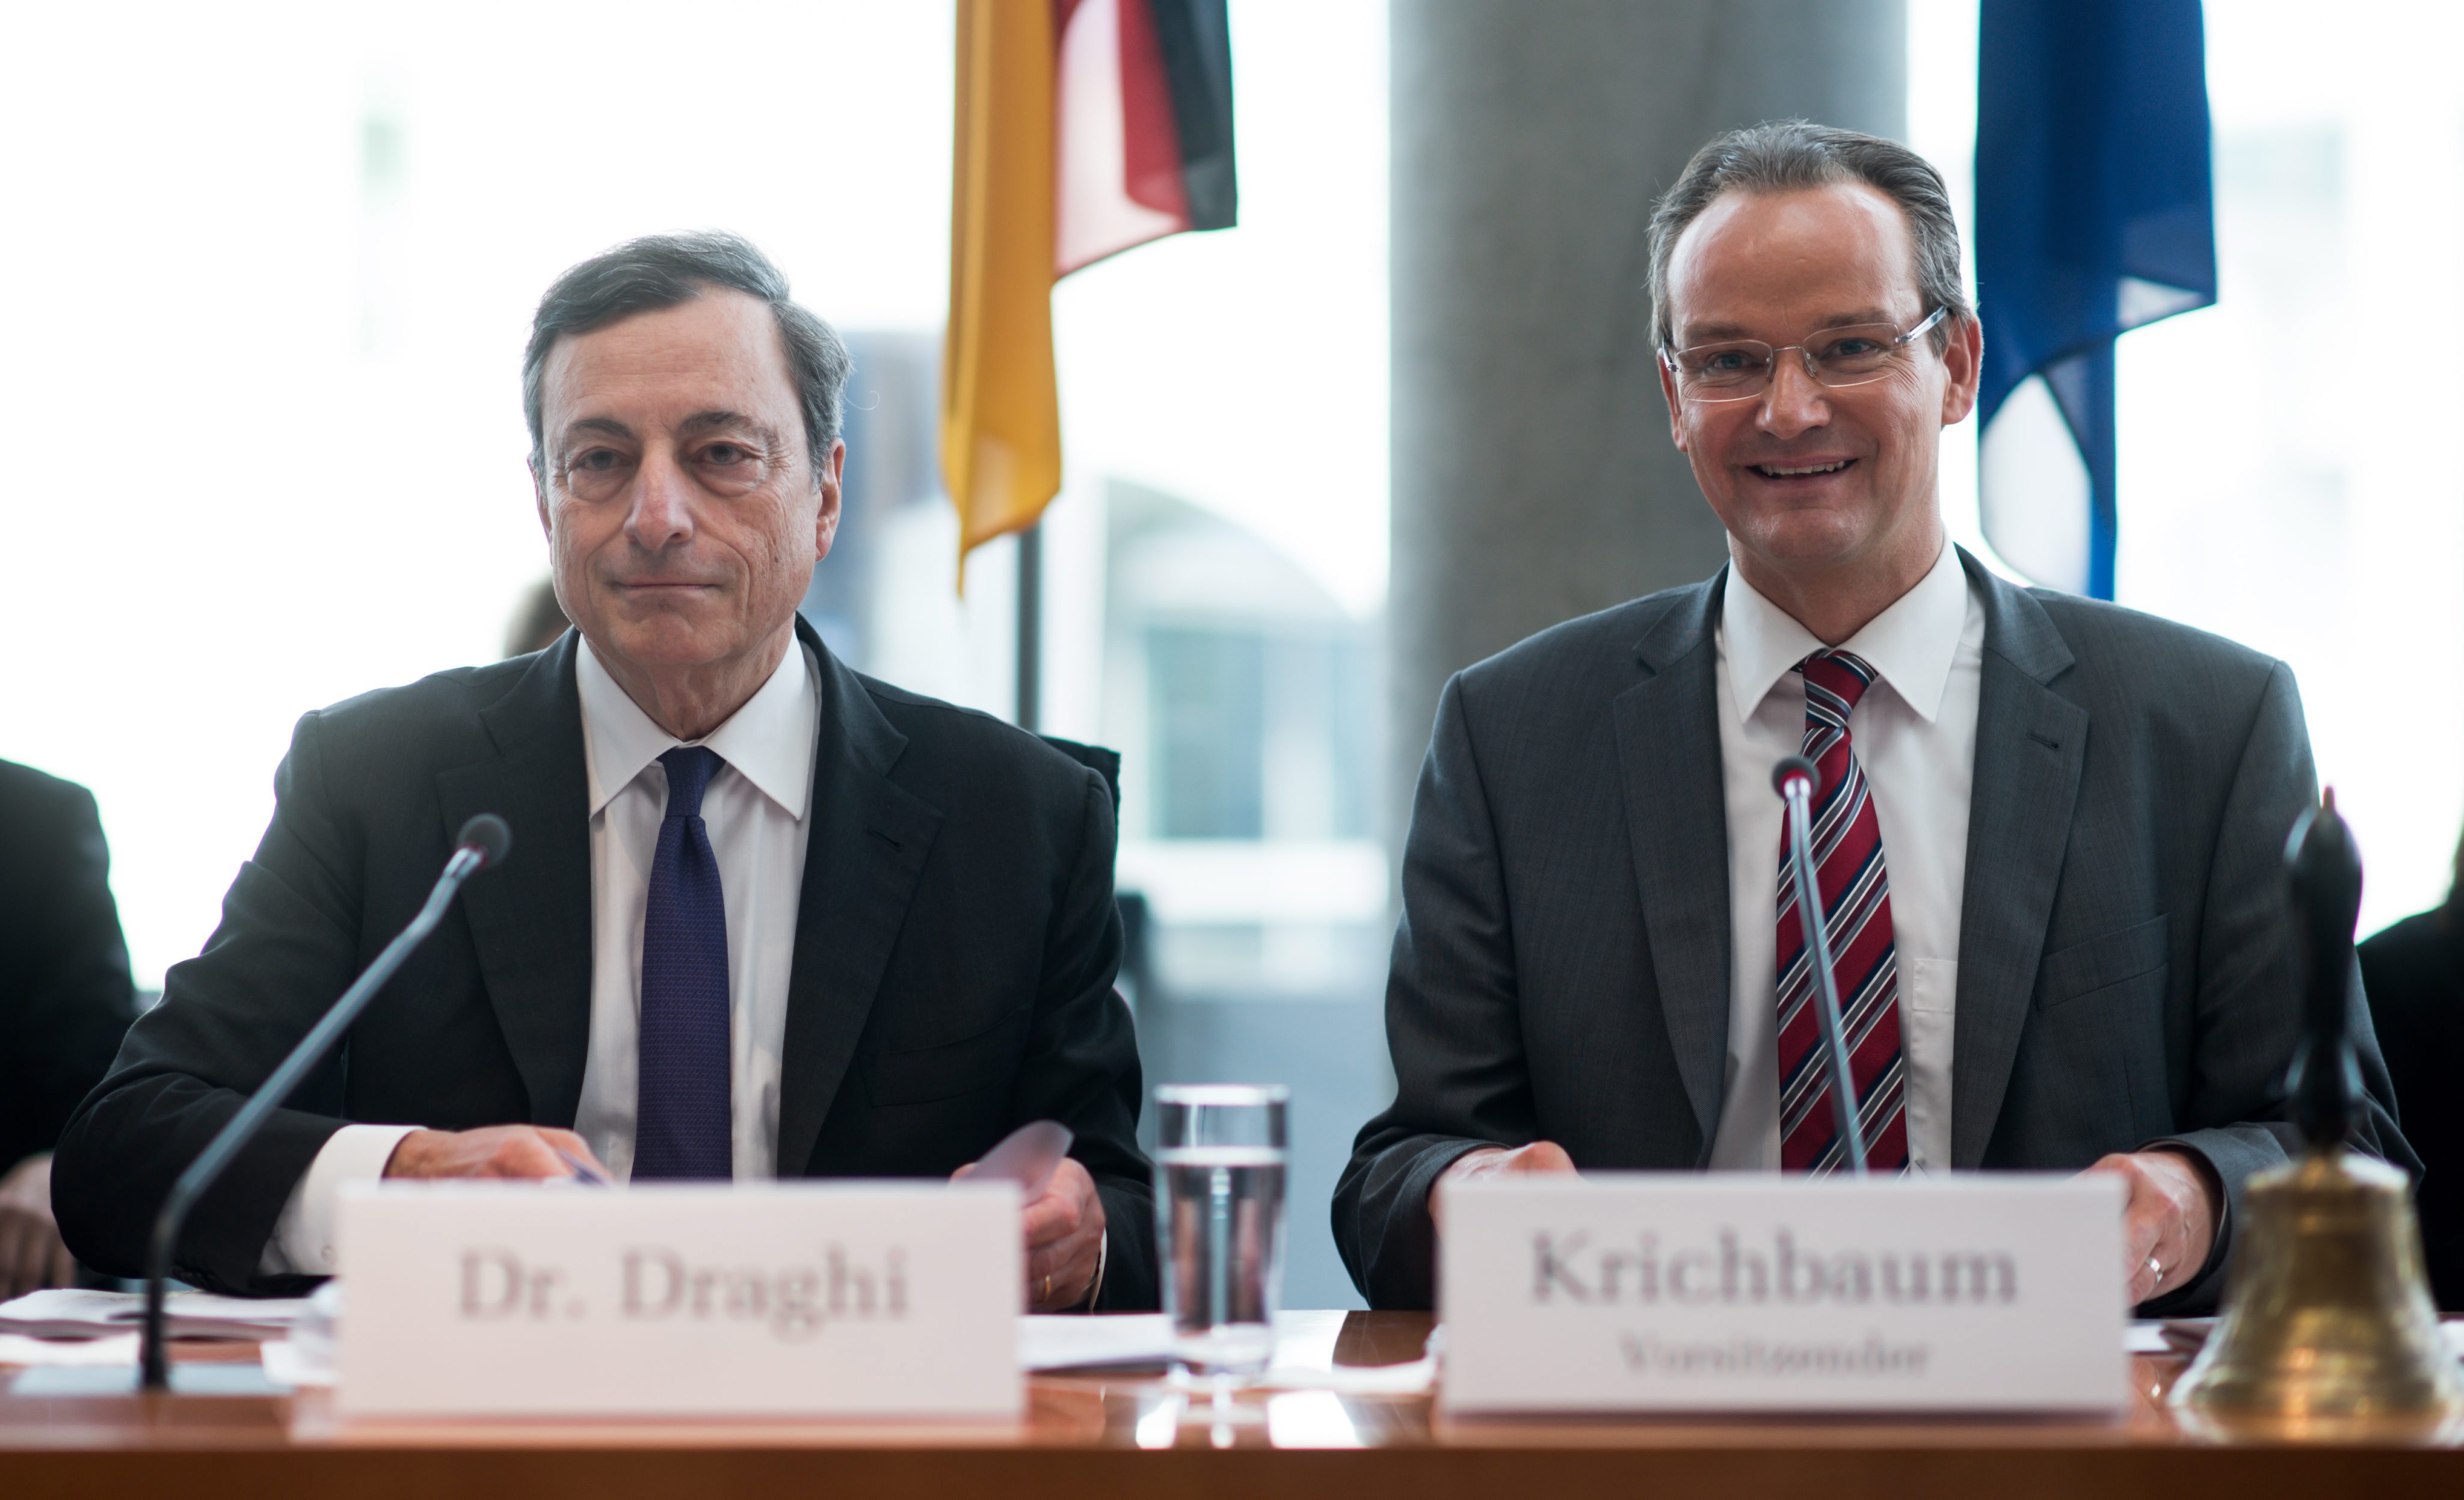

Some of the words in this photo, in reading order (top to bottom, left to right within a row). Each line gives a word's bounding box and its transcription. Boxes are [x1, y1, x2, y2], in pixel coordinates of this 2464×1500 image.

[457, 1246, 586, 1320] Dr.
[620, 1243, 910, 1344] Draghi
[1530, 1226, 2019, 1306] Krichbaum
